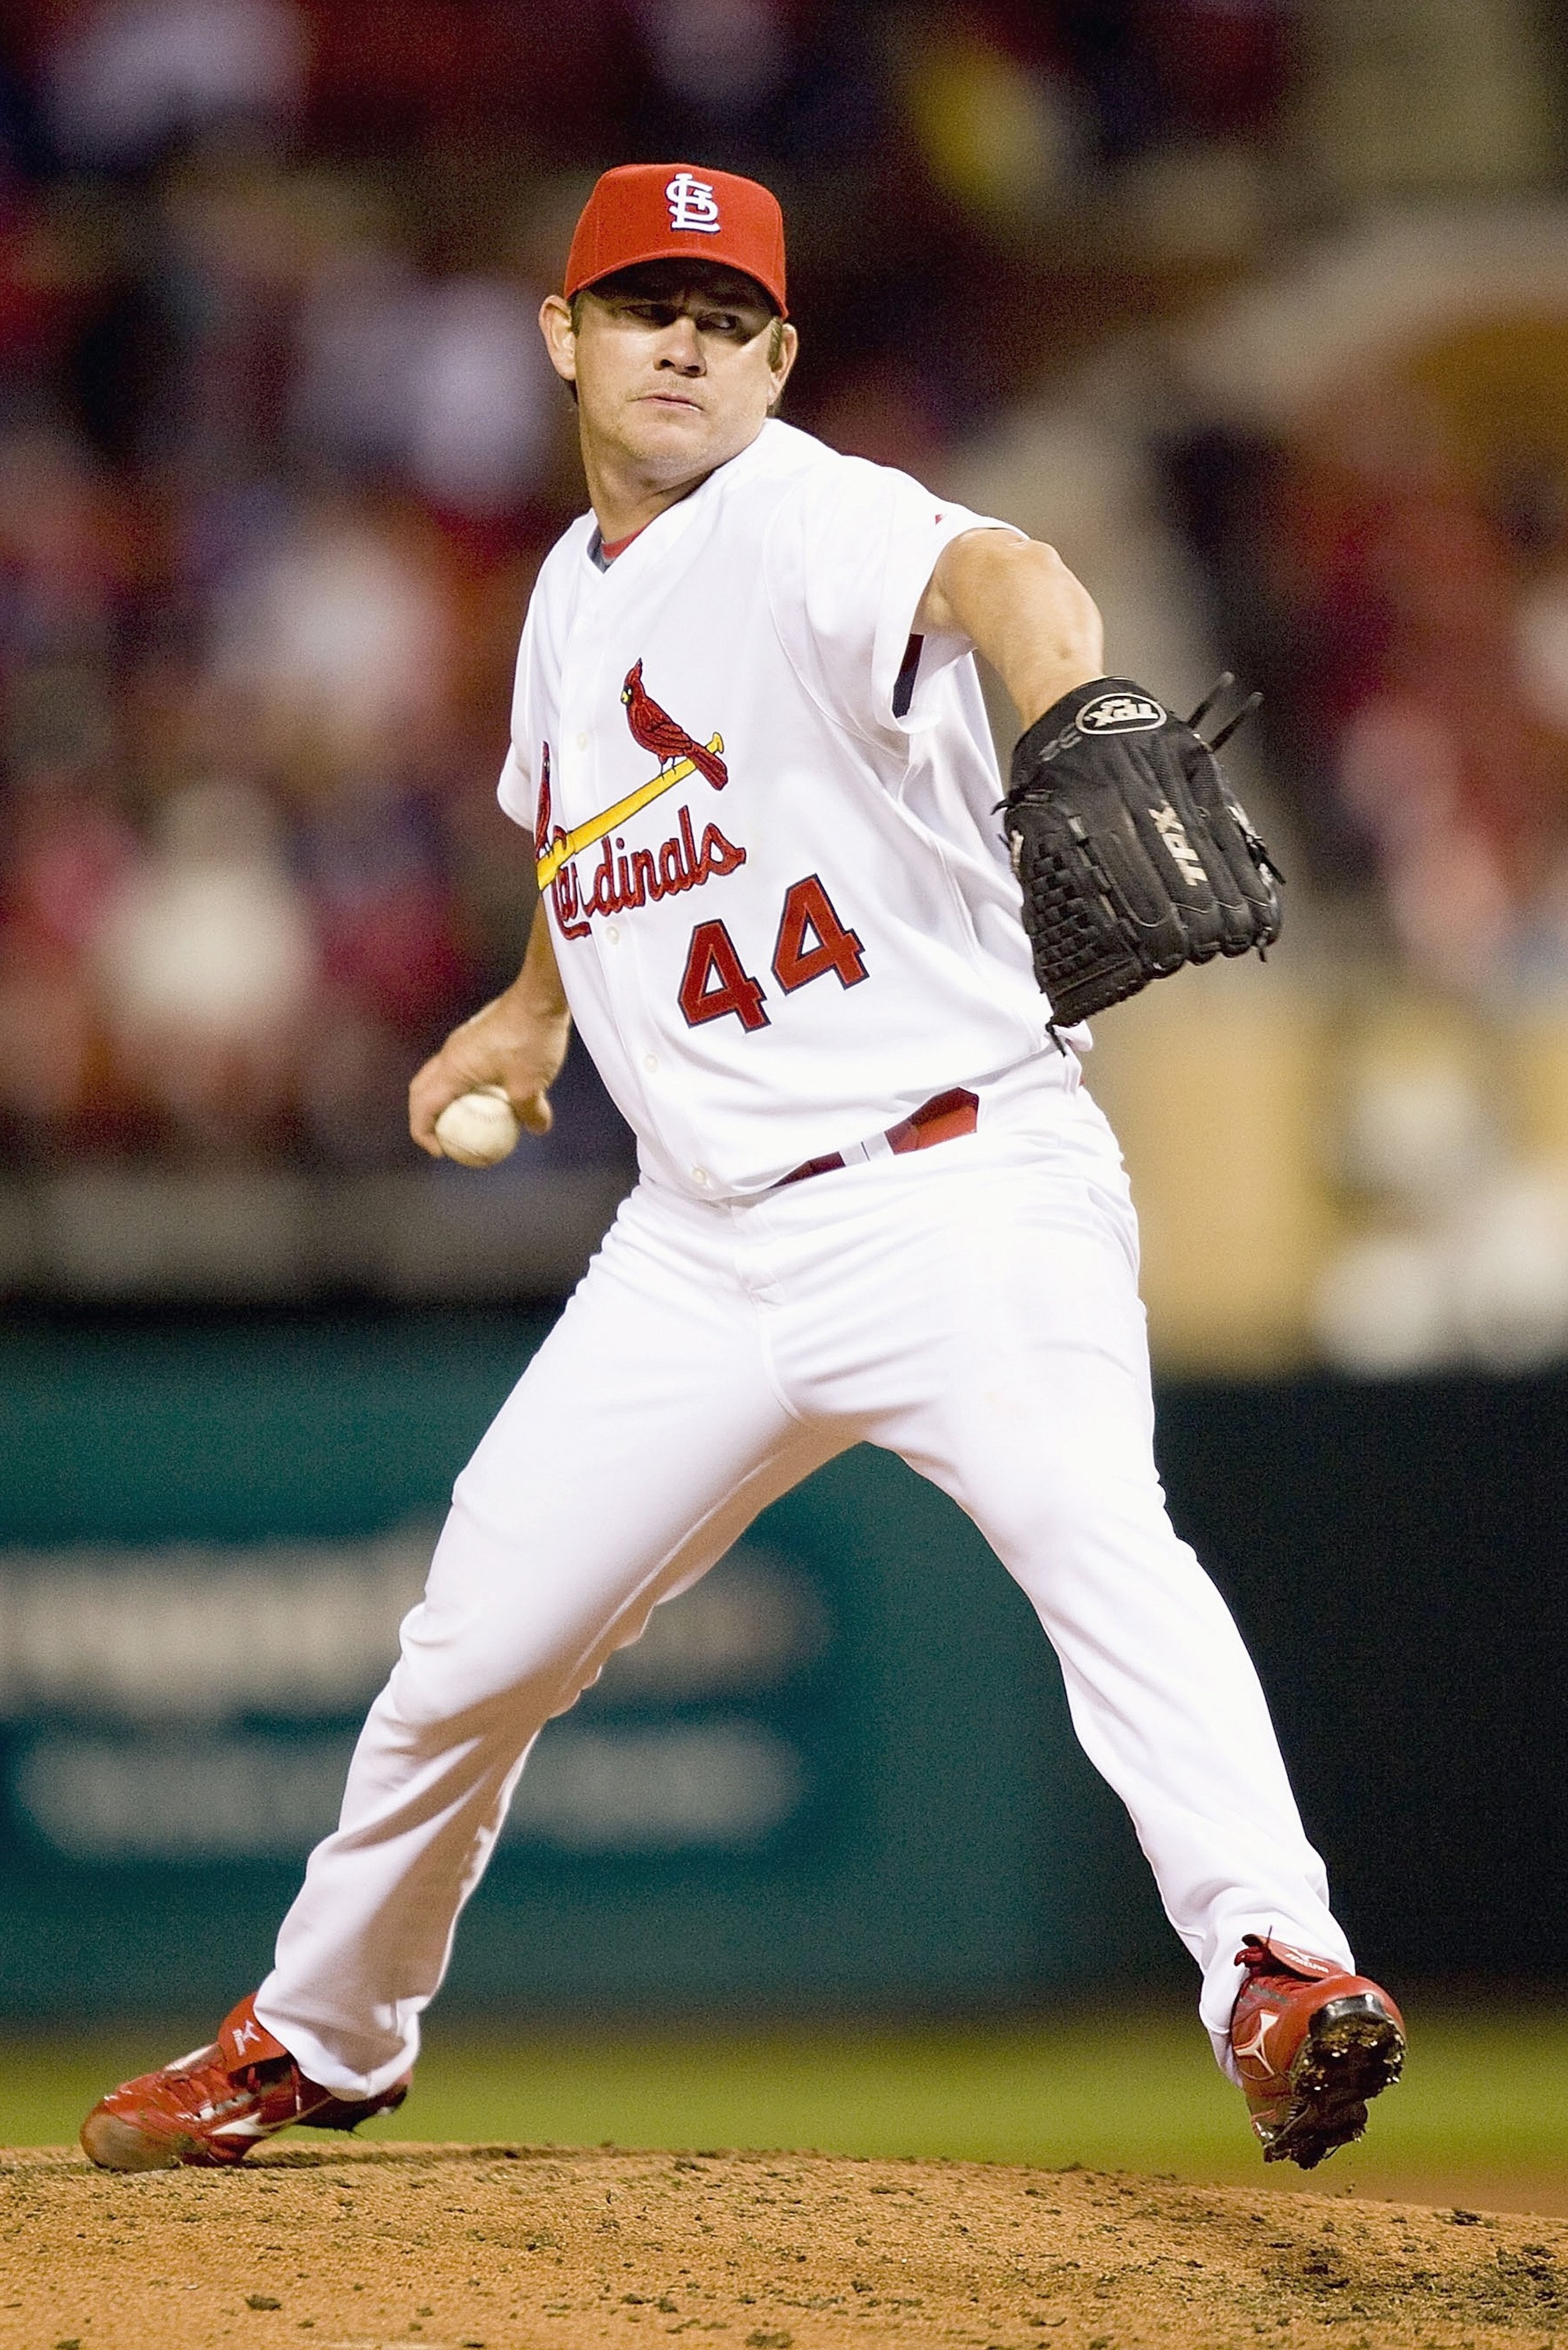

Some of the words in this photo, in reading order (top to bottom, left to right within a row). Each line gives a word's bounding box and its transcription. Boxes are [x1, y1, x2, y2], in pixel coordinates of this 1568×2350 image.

[1089, 703, 1158, 727] TPX
[1147, 799, 1208, 886] TPX
[677, 873, 870, 1033] 44
